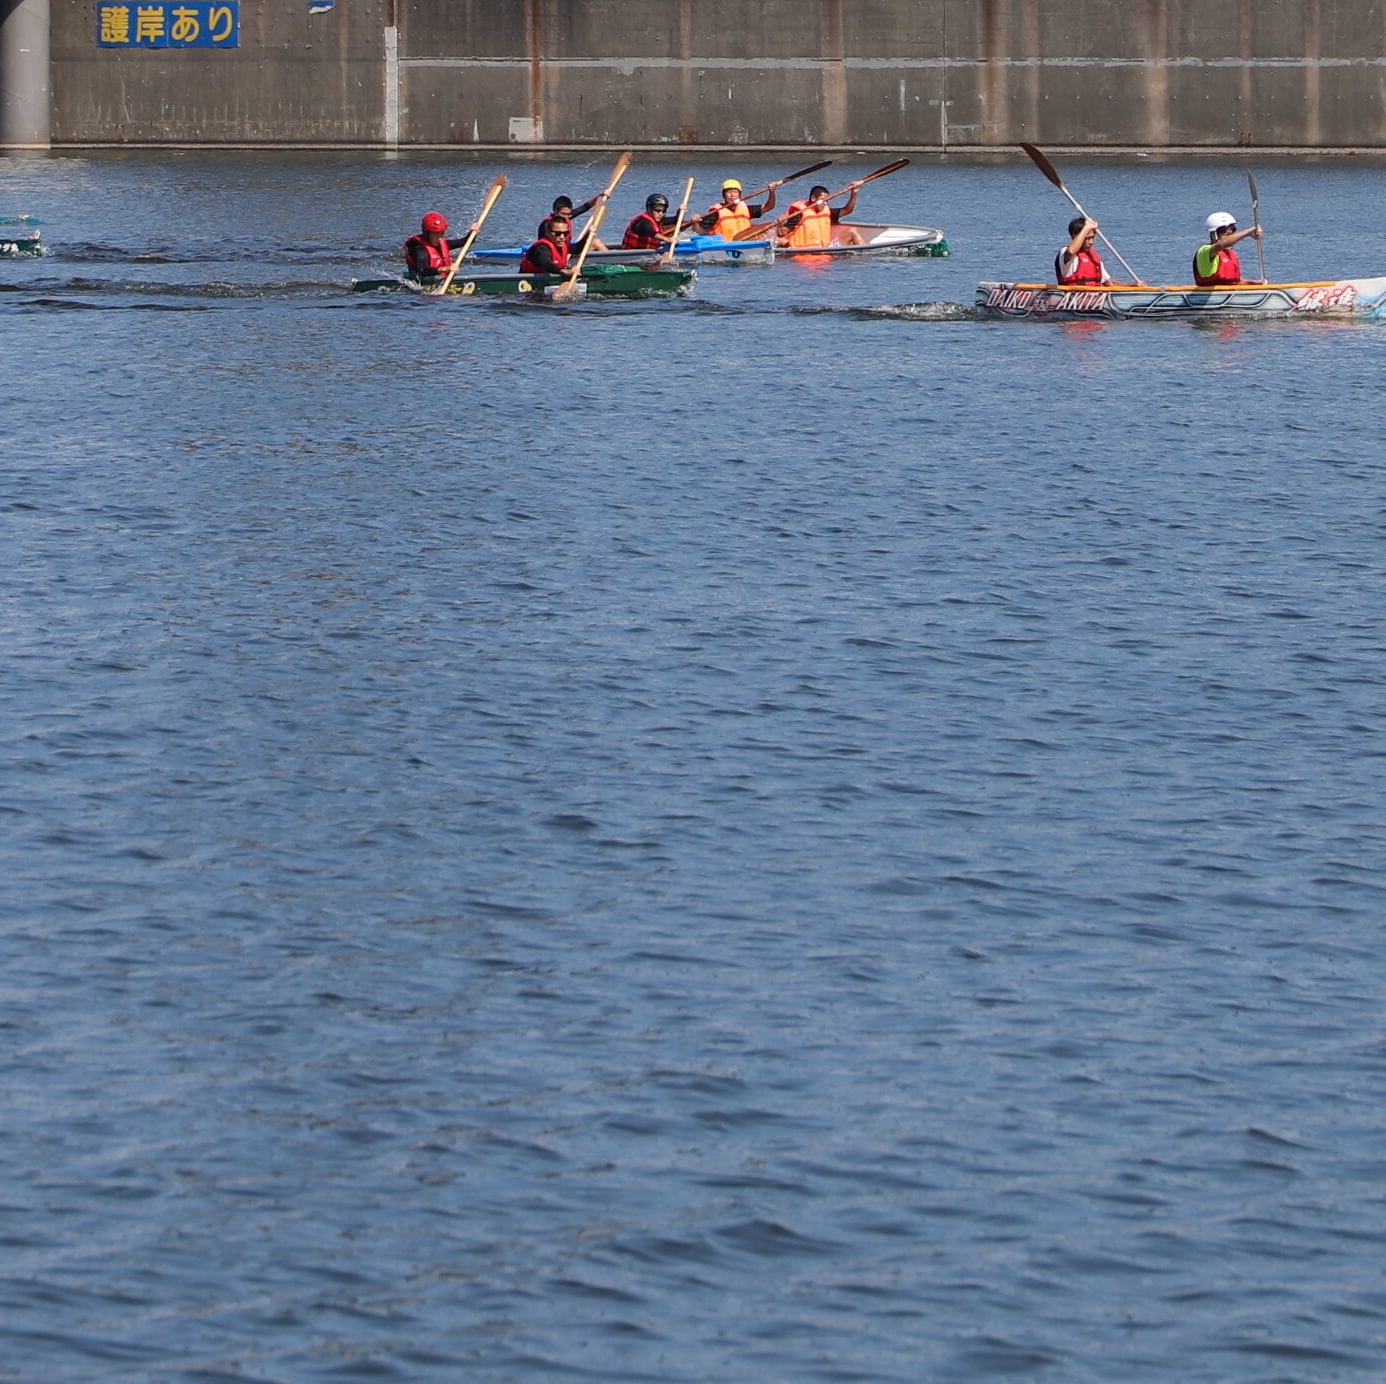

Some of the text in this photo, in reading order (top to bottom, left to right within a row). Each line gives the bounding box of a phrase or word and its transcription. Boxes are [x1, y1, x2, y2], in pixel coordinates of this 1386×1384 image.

[100, 5, 232, 43] 護岸あり
[987, 289, 1032, 308] DAIKO
[1056, 292, 1108, 310] AKITA
